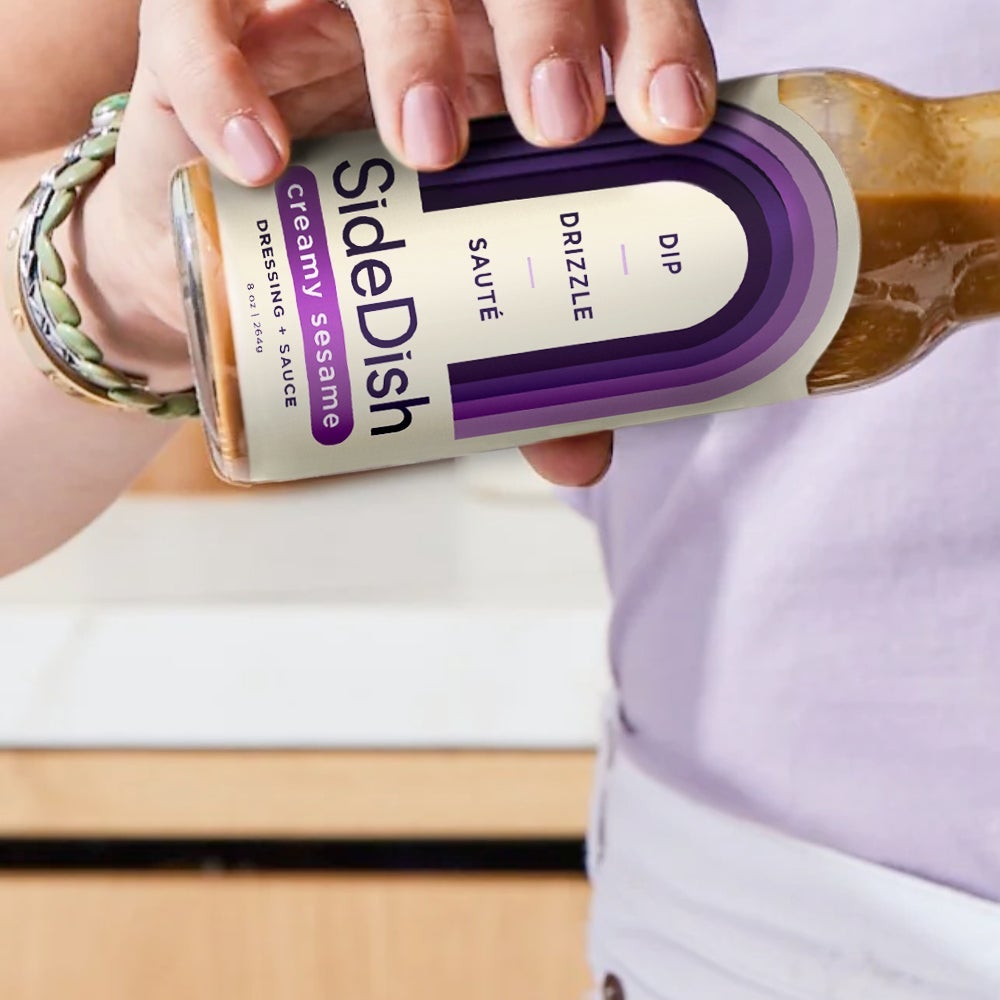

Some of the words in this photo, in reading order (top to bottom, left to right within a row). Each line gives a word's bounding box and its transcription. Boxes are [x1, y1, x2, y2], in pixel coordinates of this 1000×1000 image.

[256, 219, 285, 318] DRESSING
[469, 237, 504, 322] SAUTÉ
[560, 211, 594, 322] DRIZZLE
[659, 233, 682, 275] DIP
[246, 283, 255, 291] 8
[249, 295, 256, 309] oz
[287, 184, 323, 298] creamy
[311, 312, 340, 428] sesame
[332, 157, 430, 437] SideDish
[253, 322, 263, 353] 264g
[279, 326, 287, 335] +
[279, 344, 297, 408] SAUCE
